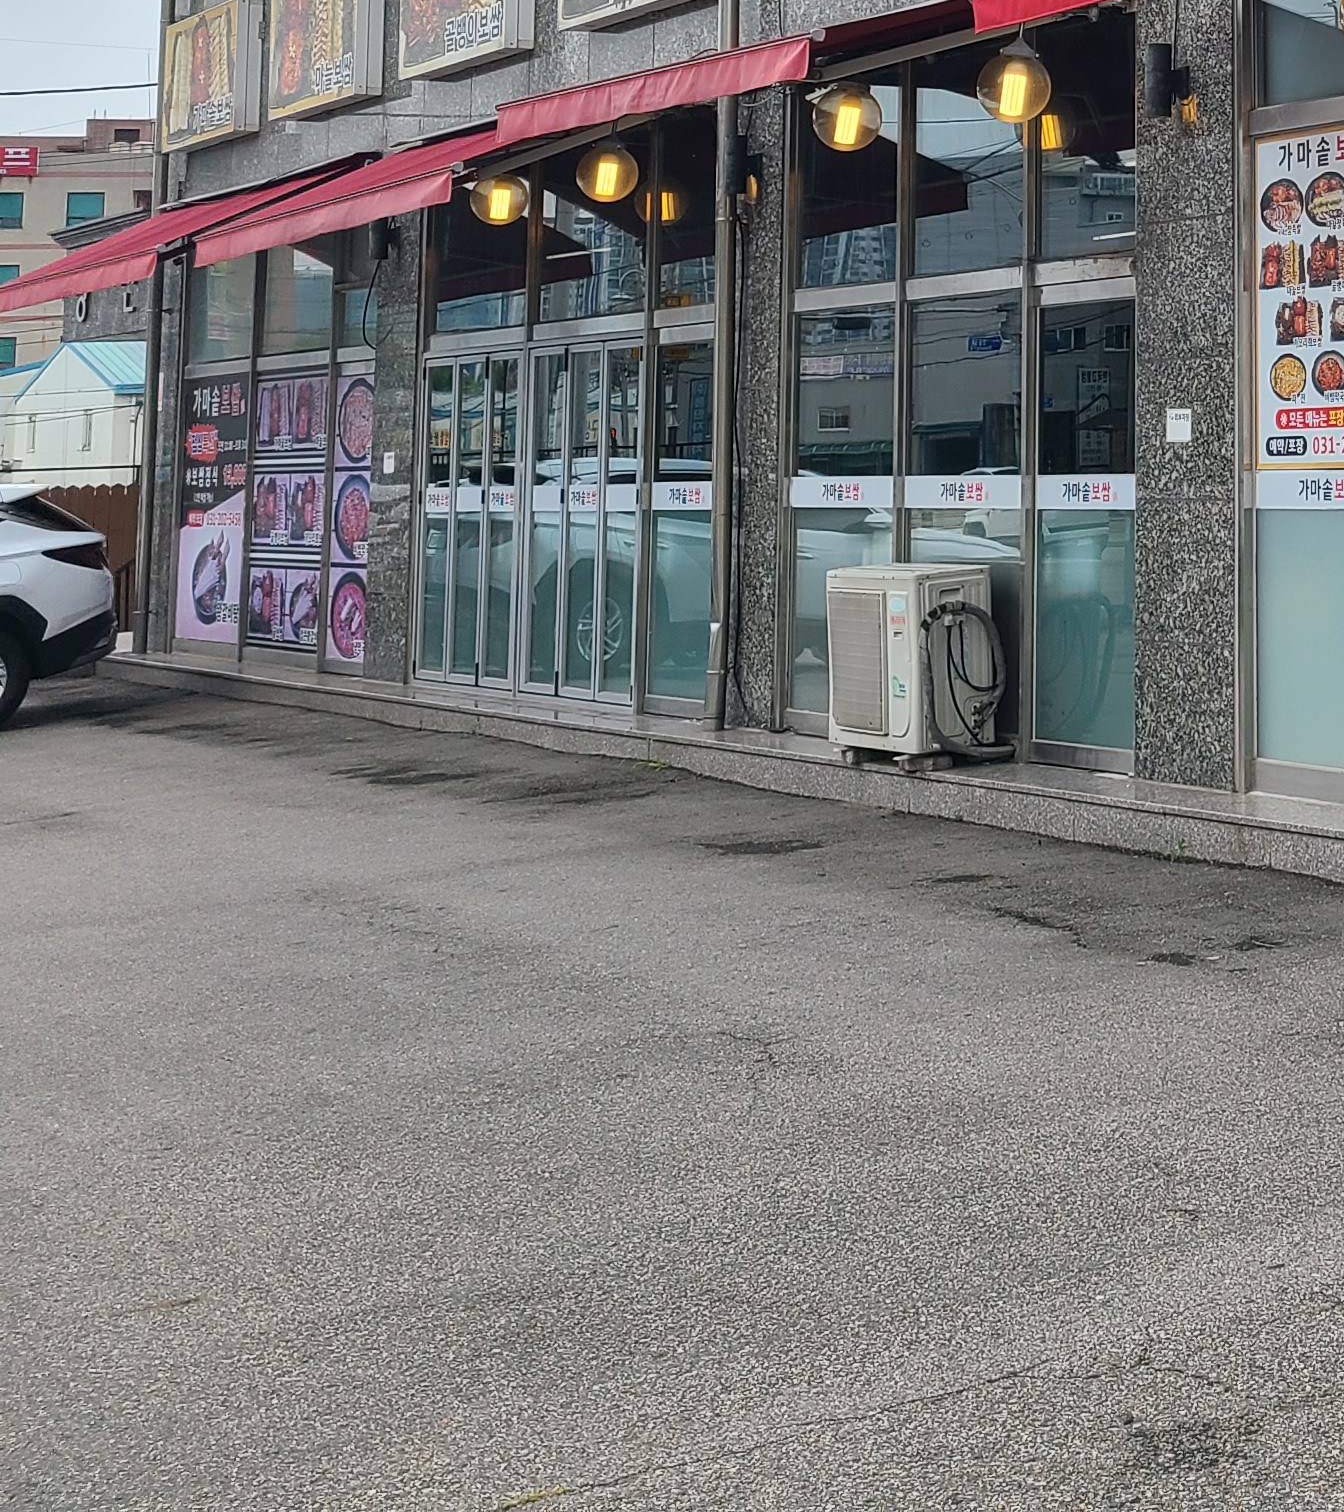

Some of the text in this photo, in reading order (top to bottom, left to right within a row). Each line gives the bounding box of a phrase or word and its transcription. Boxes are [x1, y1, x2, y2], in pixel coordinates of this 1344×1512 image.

[444, 1, 503, 54] 골뱅이보쌈
[1289, 411, 1304, 428] 모든
[1305, 410, 1327, 427] 메뉴는
[1328, 409, 1344, 427] 포장
[1268, 438, 1305, 455] 예약/포장
[668, 487, 701, 505] 가마솥보쌈
[821, 481, 860, 503] 가마솥보쌈
[940, 481, 984, 503] 가마솥보쌈
[1061, 481, 1111, 504] 가마솥보쌈
